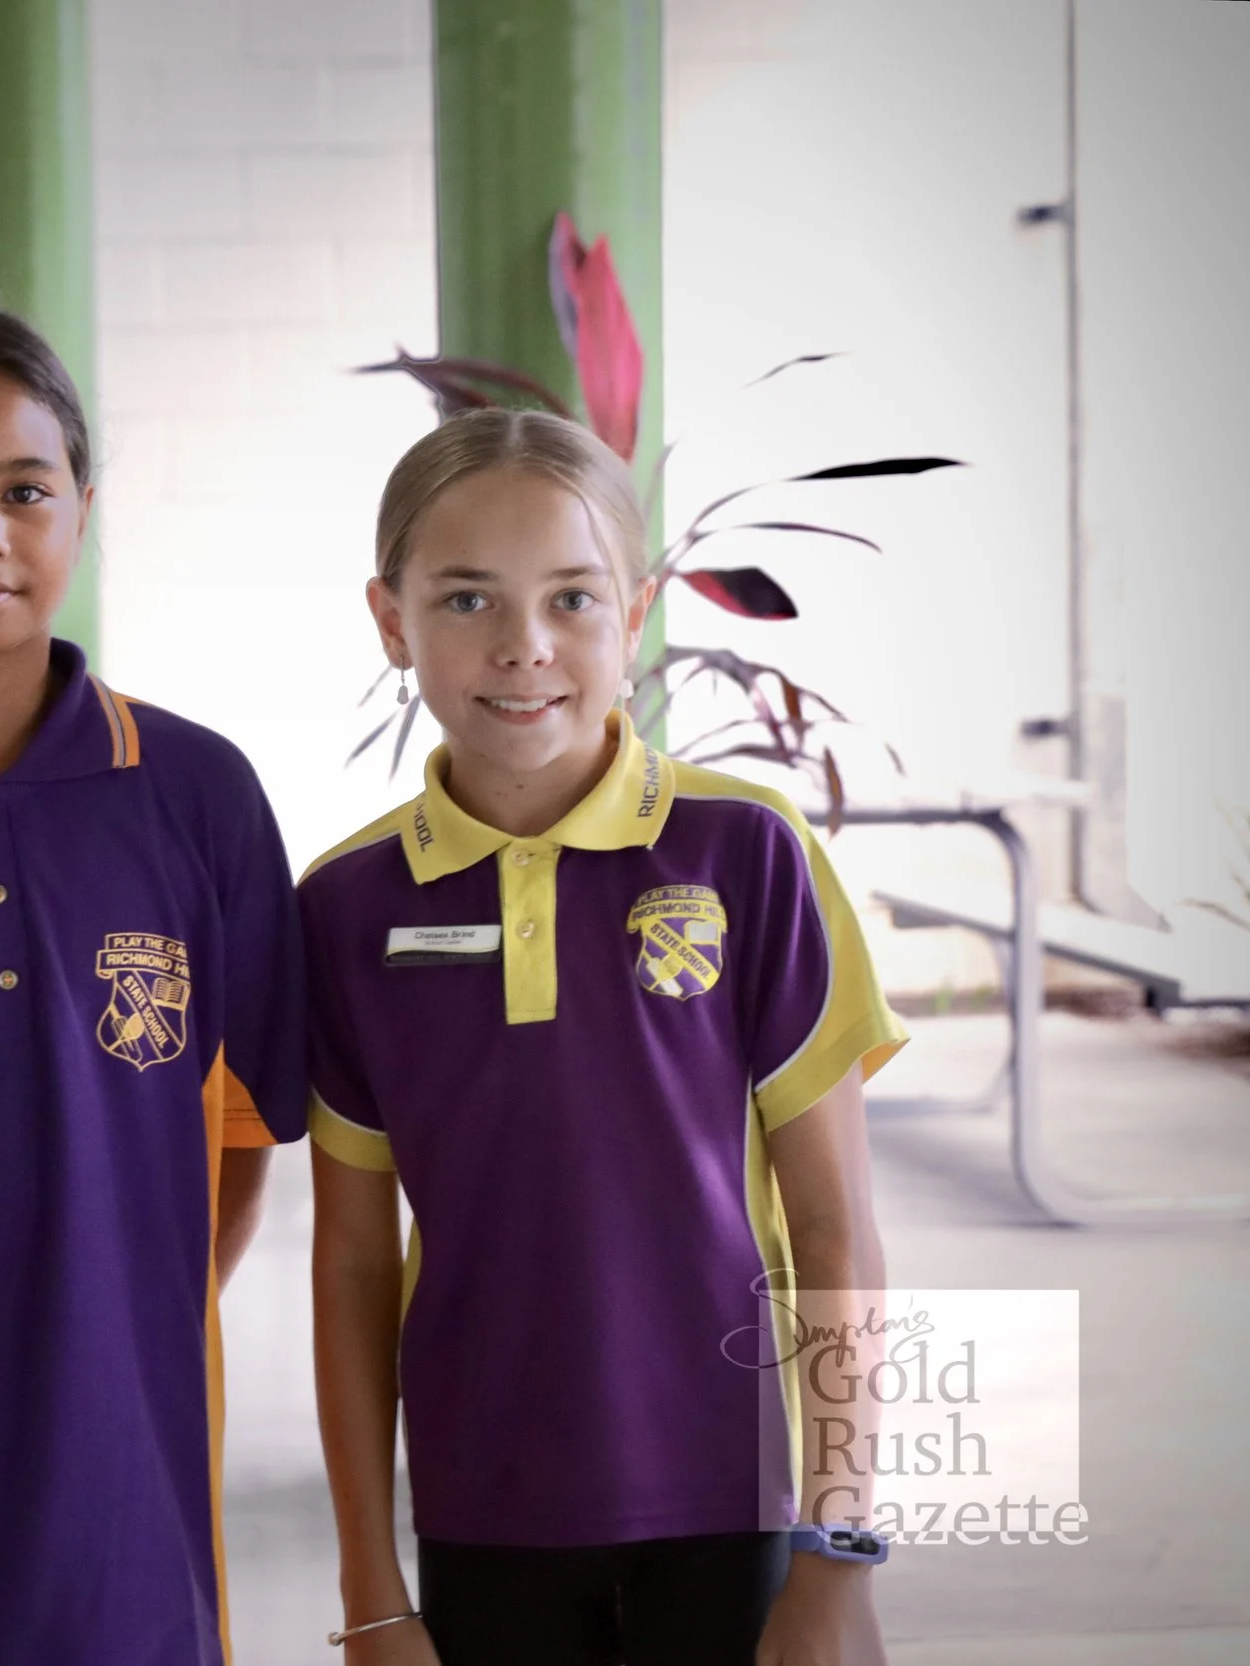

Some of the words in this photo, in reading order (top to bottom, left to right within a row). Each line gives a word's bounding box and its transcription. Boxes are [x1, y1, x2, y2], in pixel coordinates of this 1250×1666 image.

[633, 904, 700, 920] RICHMOND
[114, 937, 142, 948] PLAY
[144, 937, 165, 950] THE
[650, 923, 680, 951] STATE
[678, 946, 712, 980] SCHOOL
[107, 953, 172, 970] RICHMOND
[123, 975, 147, 1008] STATE
[144, 1007, 170, 1048] SCHOOL
